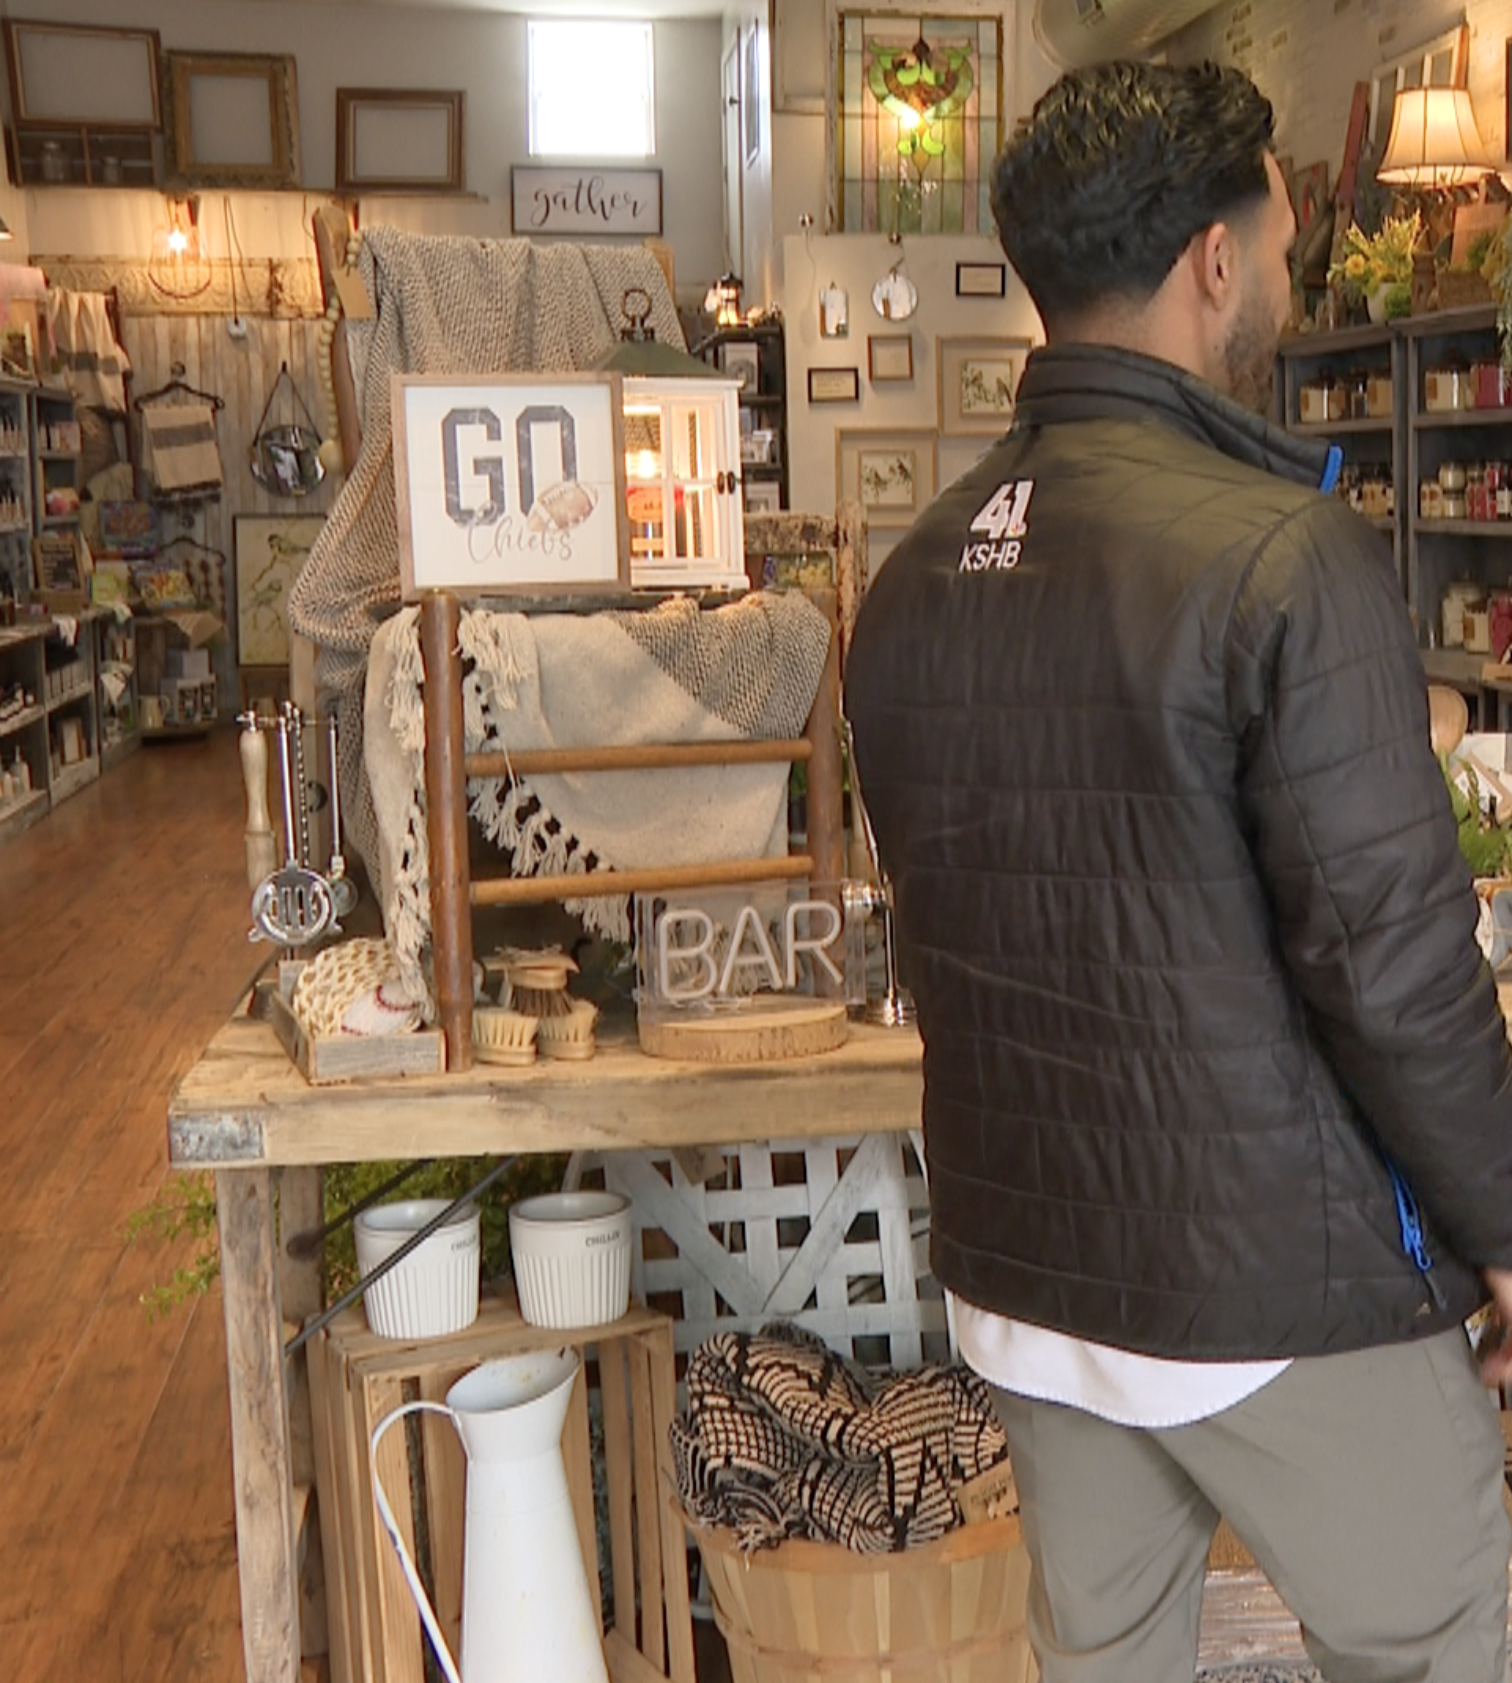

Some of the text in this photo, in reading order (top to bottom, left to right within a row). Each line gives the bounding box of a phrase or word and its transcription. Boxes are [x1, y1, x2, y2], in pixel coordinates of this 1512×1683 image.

[531, 176, 648, 227] gather
[441, 404, 577, 527] GO
[969, 480, 1034, 539] 41
[959, 540, 1021, 572] KSHB
[659, 902, 844, 1000] BAR
